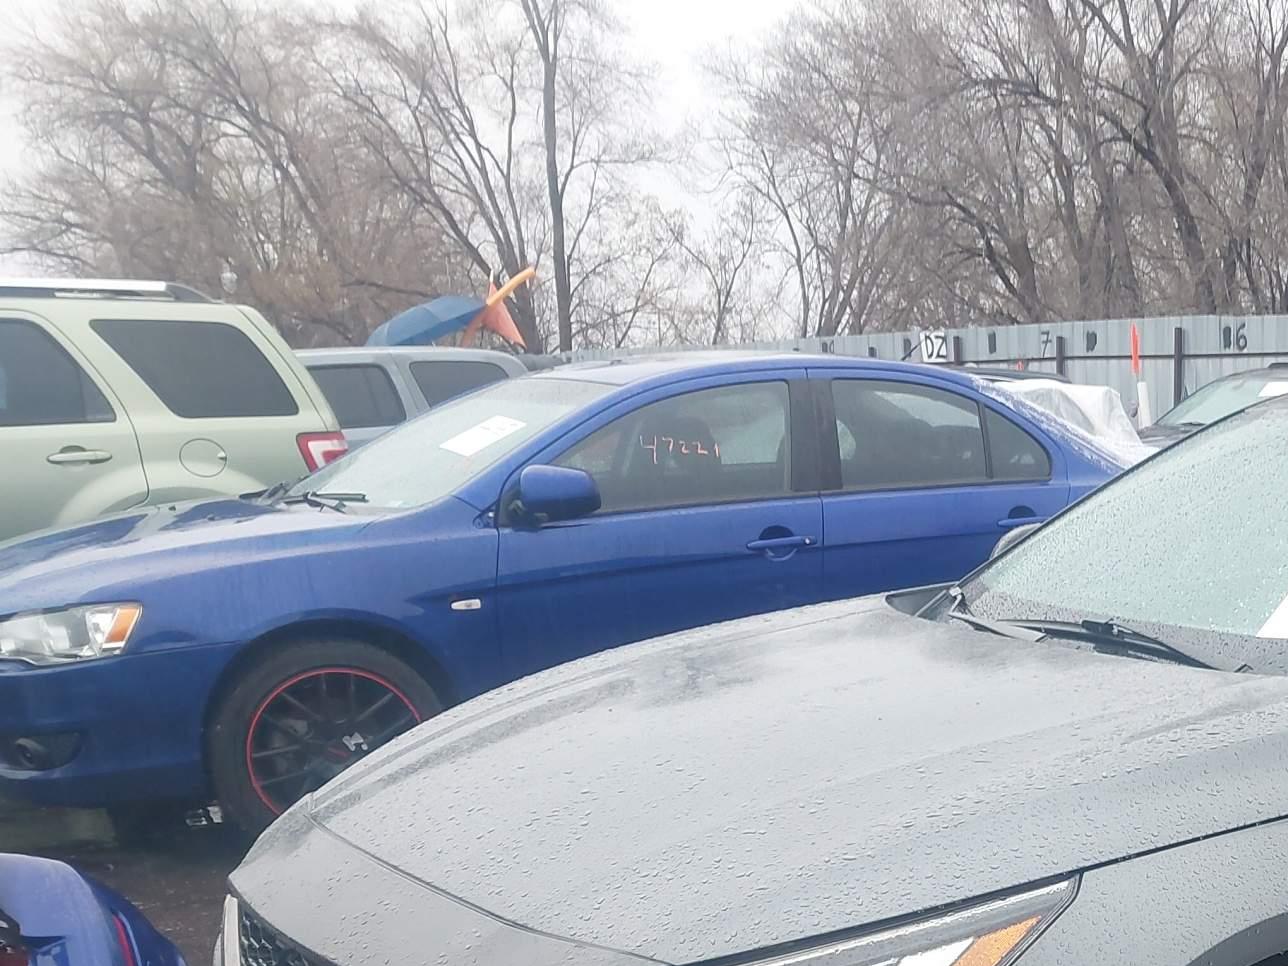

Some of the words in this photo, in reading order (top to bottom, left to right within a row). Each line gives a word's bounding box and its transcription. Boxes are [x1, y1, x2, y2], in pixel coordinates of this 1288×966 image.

[1041, 330, 1052, 358] 7
[1235, 322, 1248, 351] 6
[639, 434, 720, 465] 47221
